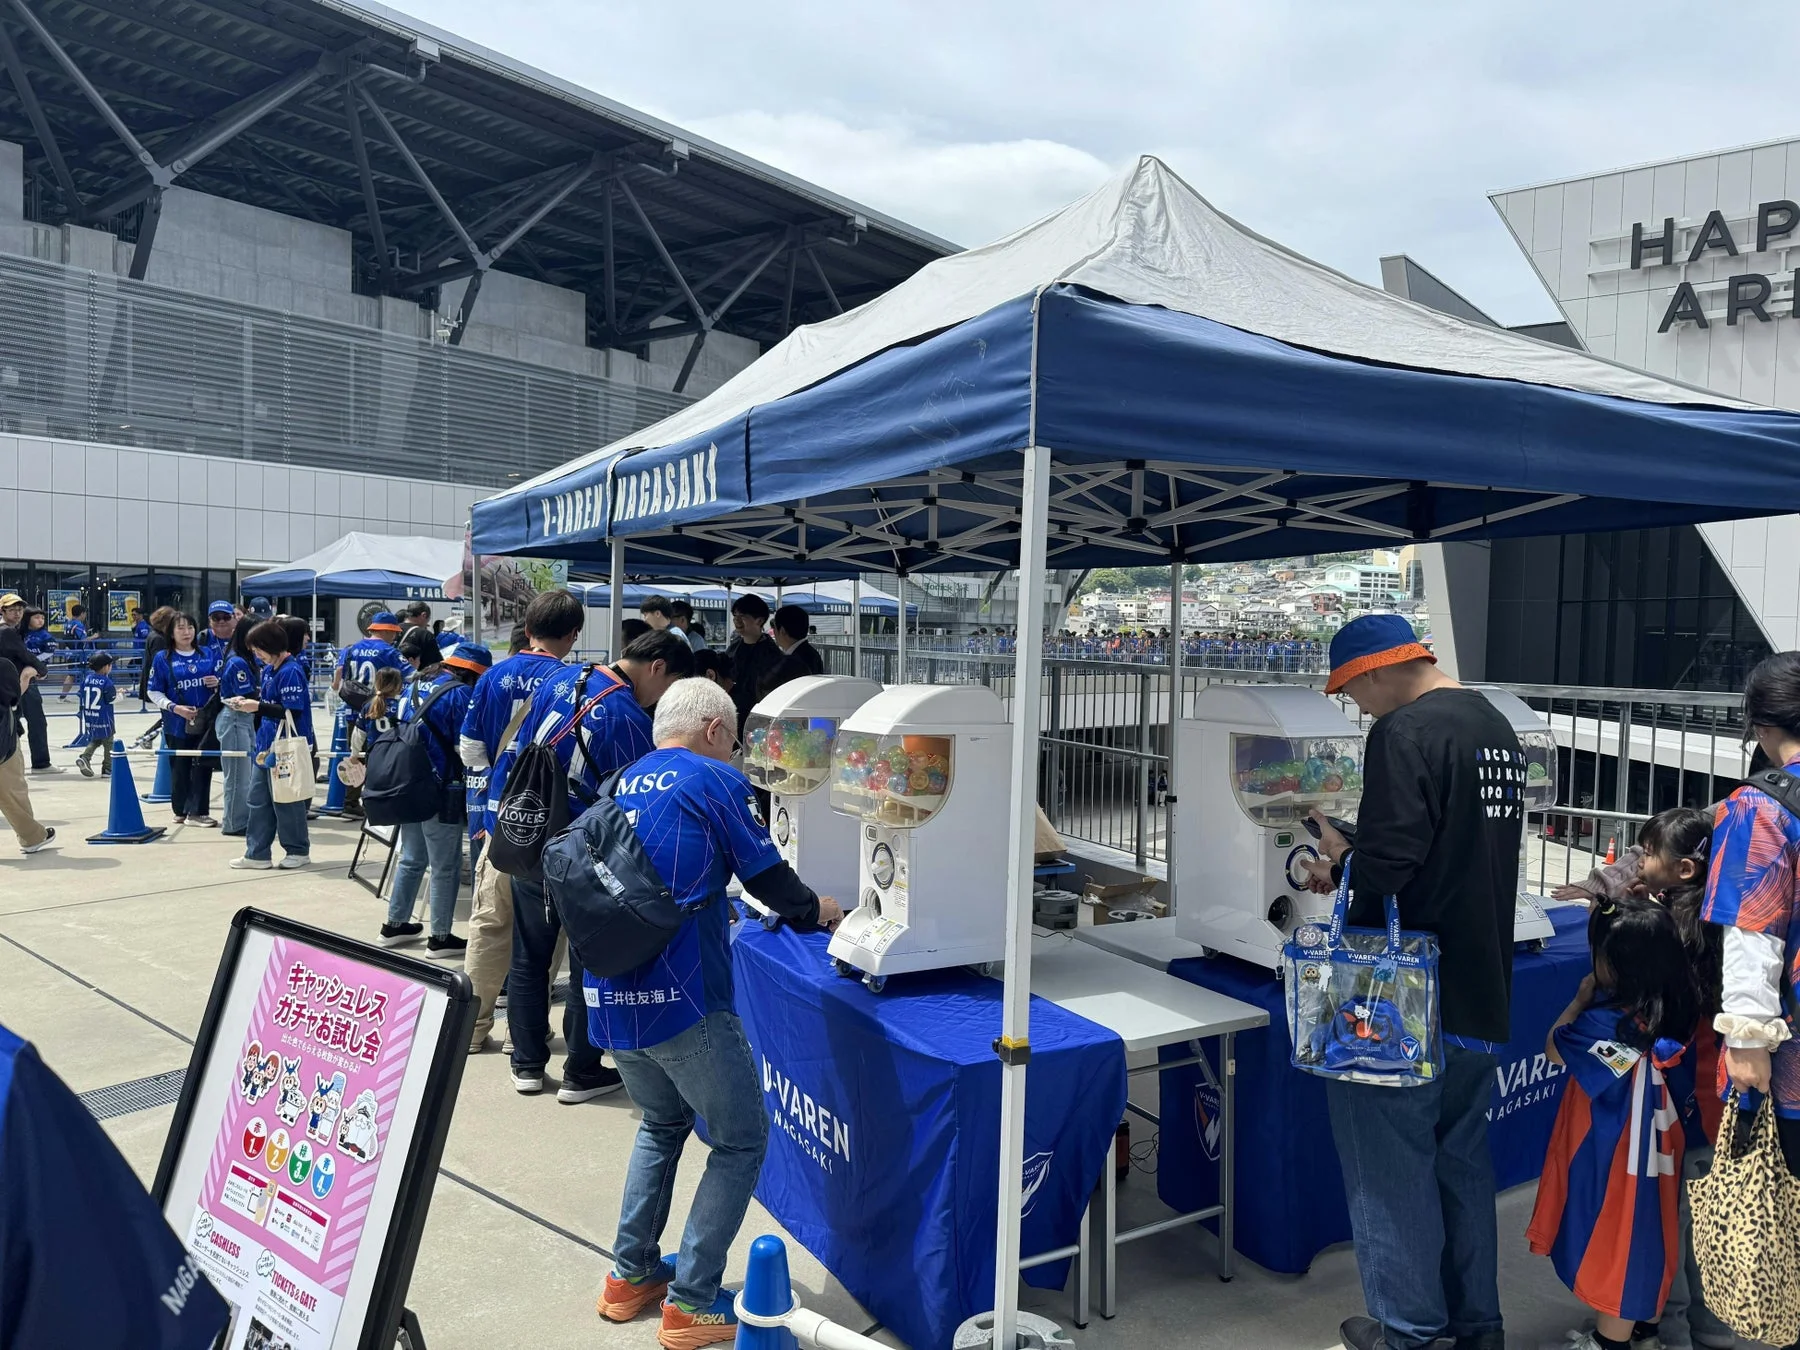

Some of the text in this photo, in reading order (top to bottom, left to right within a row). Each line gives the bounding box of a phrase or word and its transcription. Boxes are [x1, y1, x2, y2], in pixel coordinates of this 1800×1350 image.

[1630, 199, 1800, 270] HAP
[541, 441, 718, 537] V-VAREN NAGASAKI
[690, 598, 726, 609] NAGASAKI
[823, 603, 850, 613] V-VAREN
[359, 649, 380, 658] MSC
[83, 686, 102, 711] 12
[614, 770, 679, 797] MSC
[505, 809, 546, 824] LOVERS
[1303, 931, 1317, 941] 20
[1329, 913, 1339, 942] V-VAREN
[1393, 918, 1401, 947] V-VAREN
[1347, 953, 1377, 962] V-VAREN
[288, 963, 388, 1023] キャッシュレス
[603, 986, 682, 1006] 三井住友海上
[275, 996, 381, 1062] ガチャお試し会
[762, 1053, 850, 1163] V-VAREN
[773, 1109, 833, 1175] NAGASAKI
[210, 1230, 241, 1259] CASHLESS
[691, 1312, 726, 1325] HOKA
